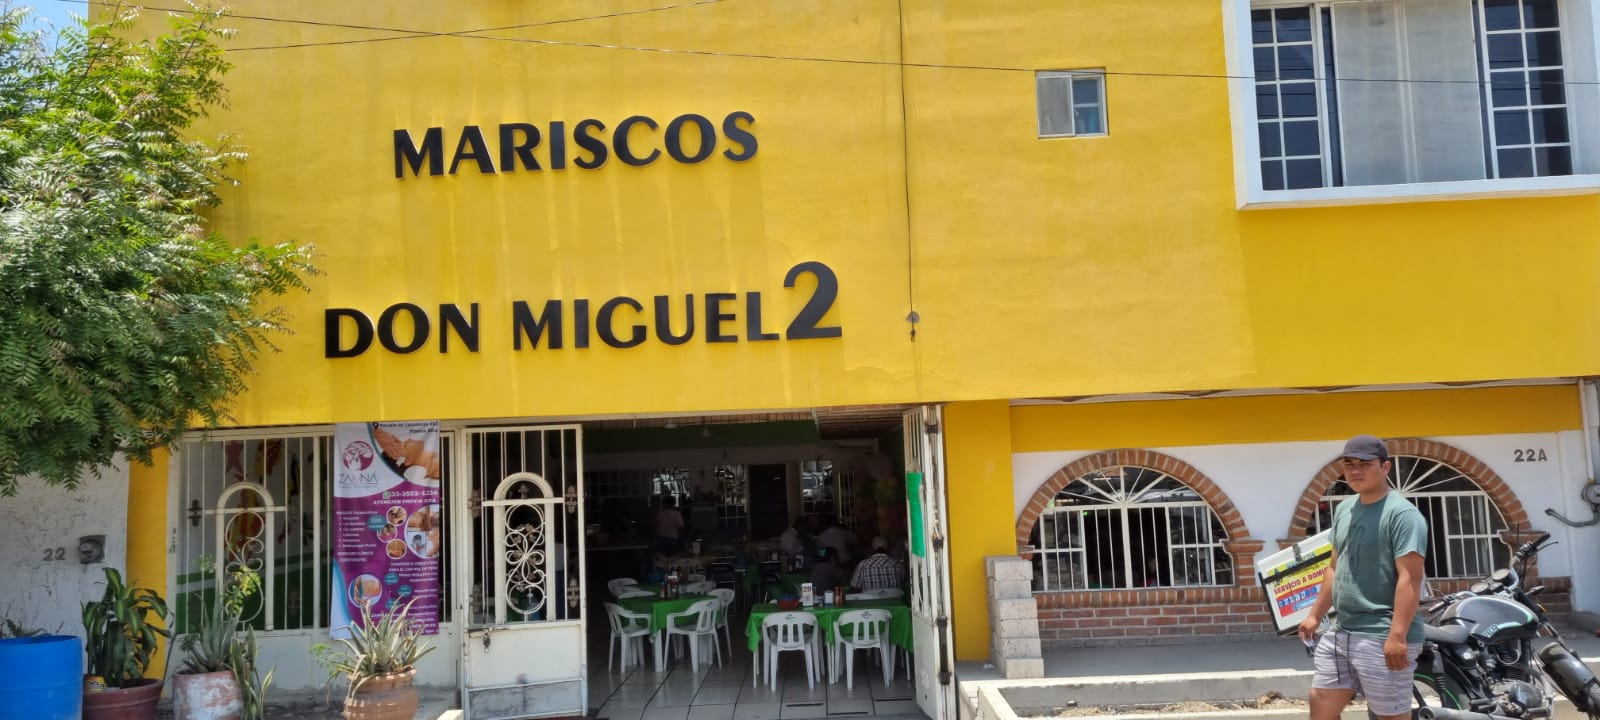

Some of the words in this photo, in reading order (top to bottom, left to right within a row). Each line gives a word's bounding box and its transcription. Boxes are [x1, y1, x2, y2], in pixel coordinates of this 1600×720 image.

[393, 111, 759, 179] MARISCOS
[324, 302, 480, 359] DON
[512, 291, 780, 351] MIGUEL
[783, 261, 843, 340] 2
[1513, 448, 1548, 462] 22A
[43, 547, 66, 562] 22
[1273, 580, 1301, 595] SERVICIO
